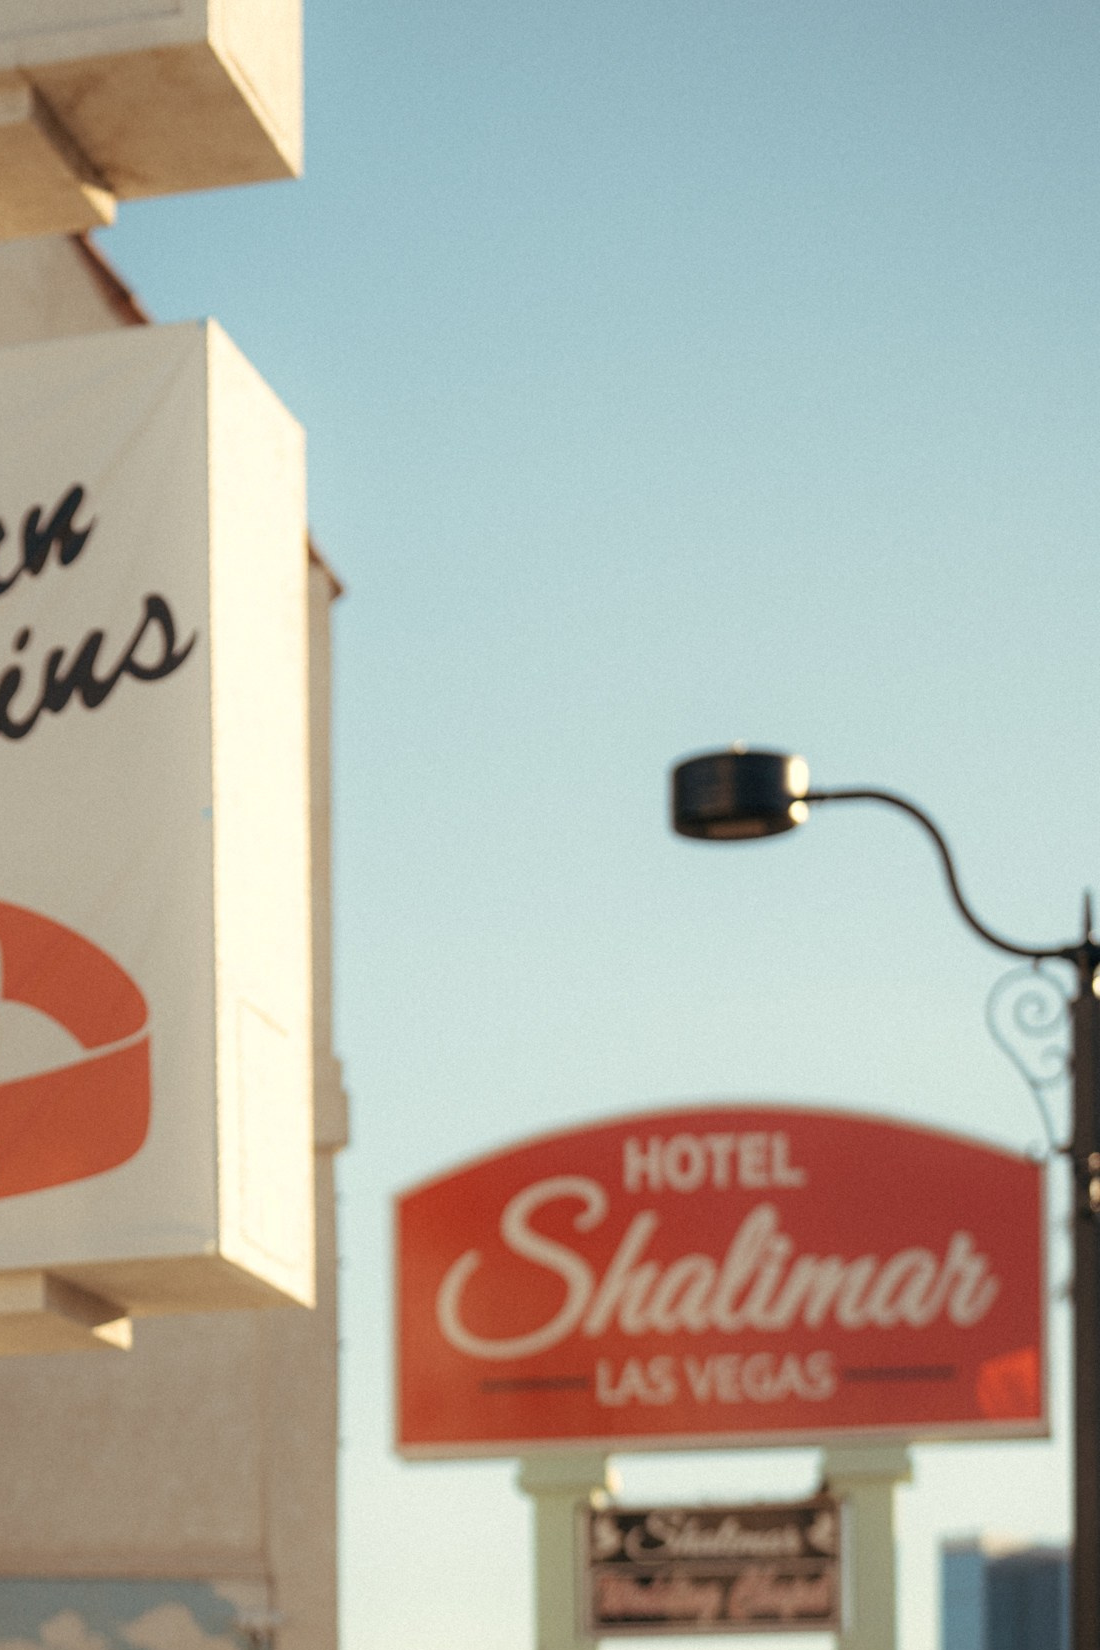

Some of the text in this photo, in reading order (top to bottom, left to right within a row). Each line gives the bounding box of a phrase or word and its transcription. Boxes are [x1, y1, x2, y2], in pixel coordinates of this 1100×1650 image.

[622, 1132, 807, 1192] HOTEL
[437, 1175, 999, 1360] Shalimar
[597, 1350, 836, 1406] LAS VEGAS
